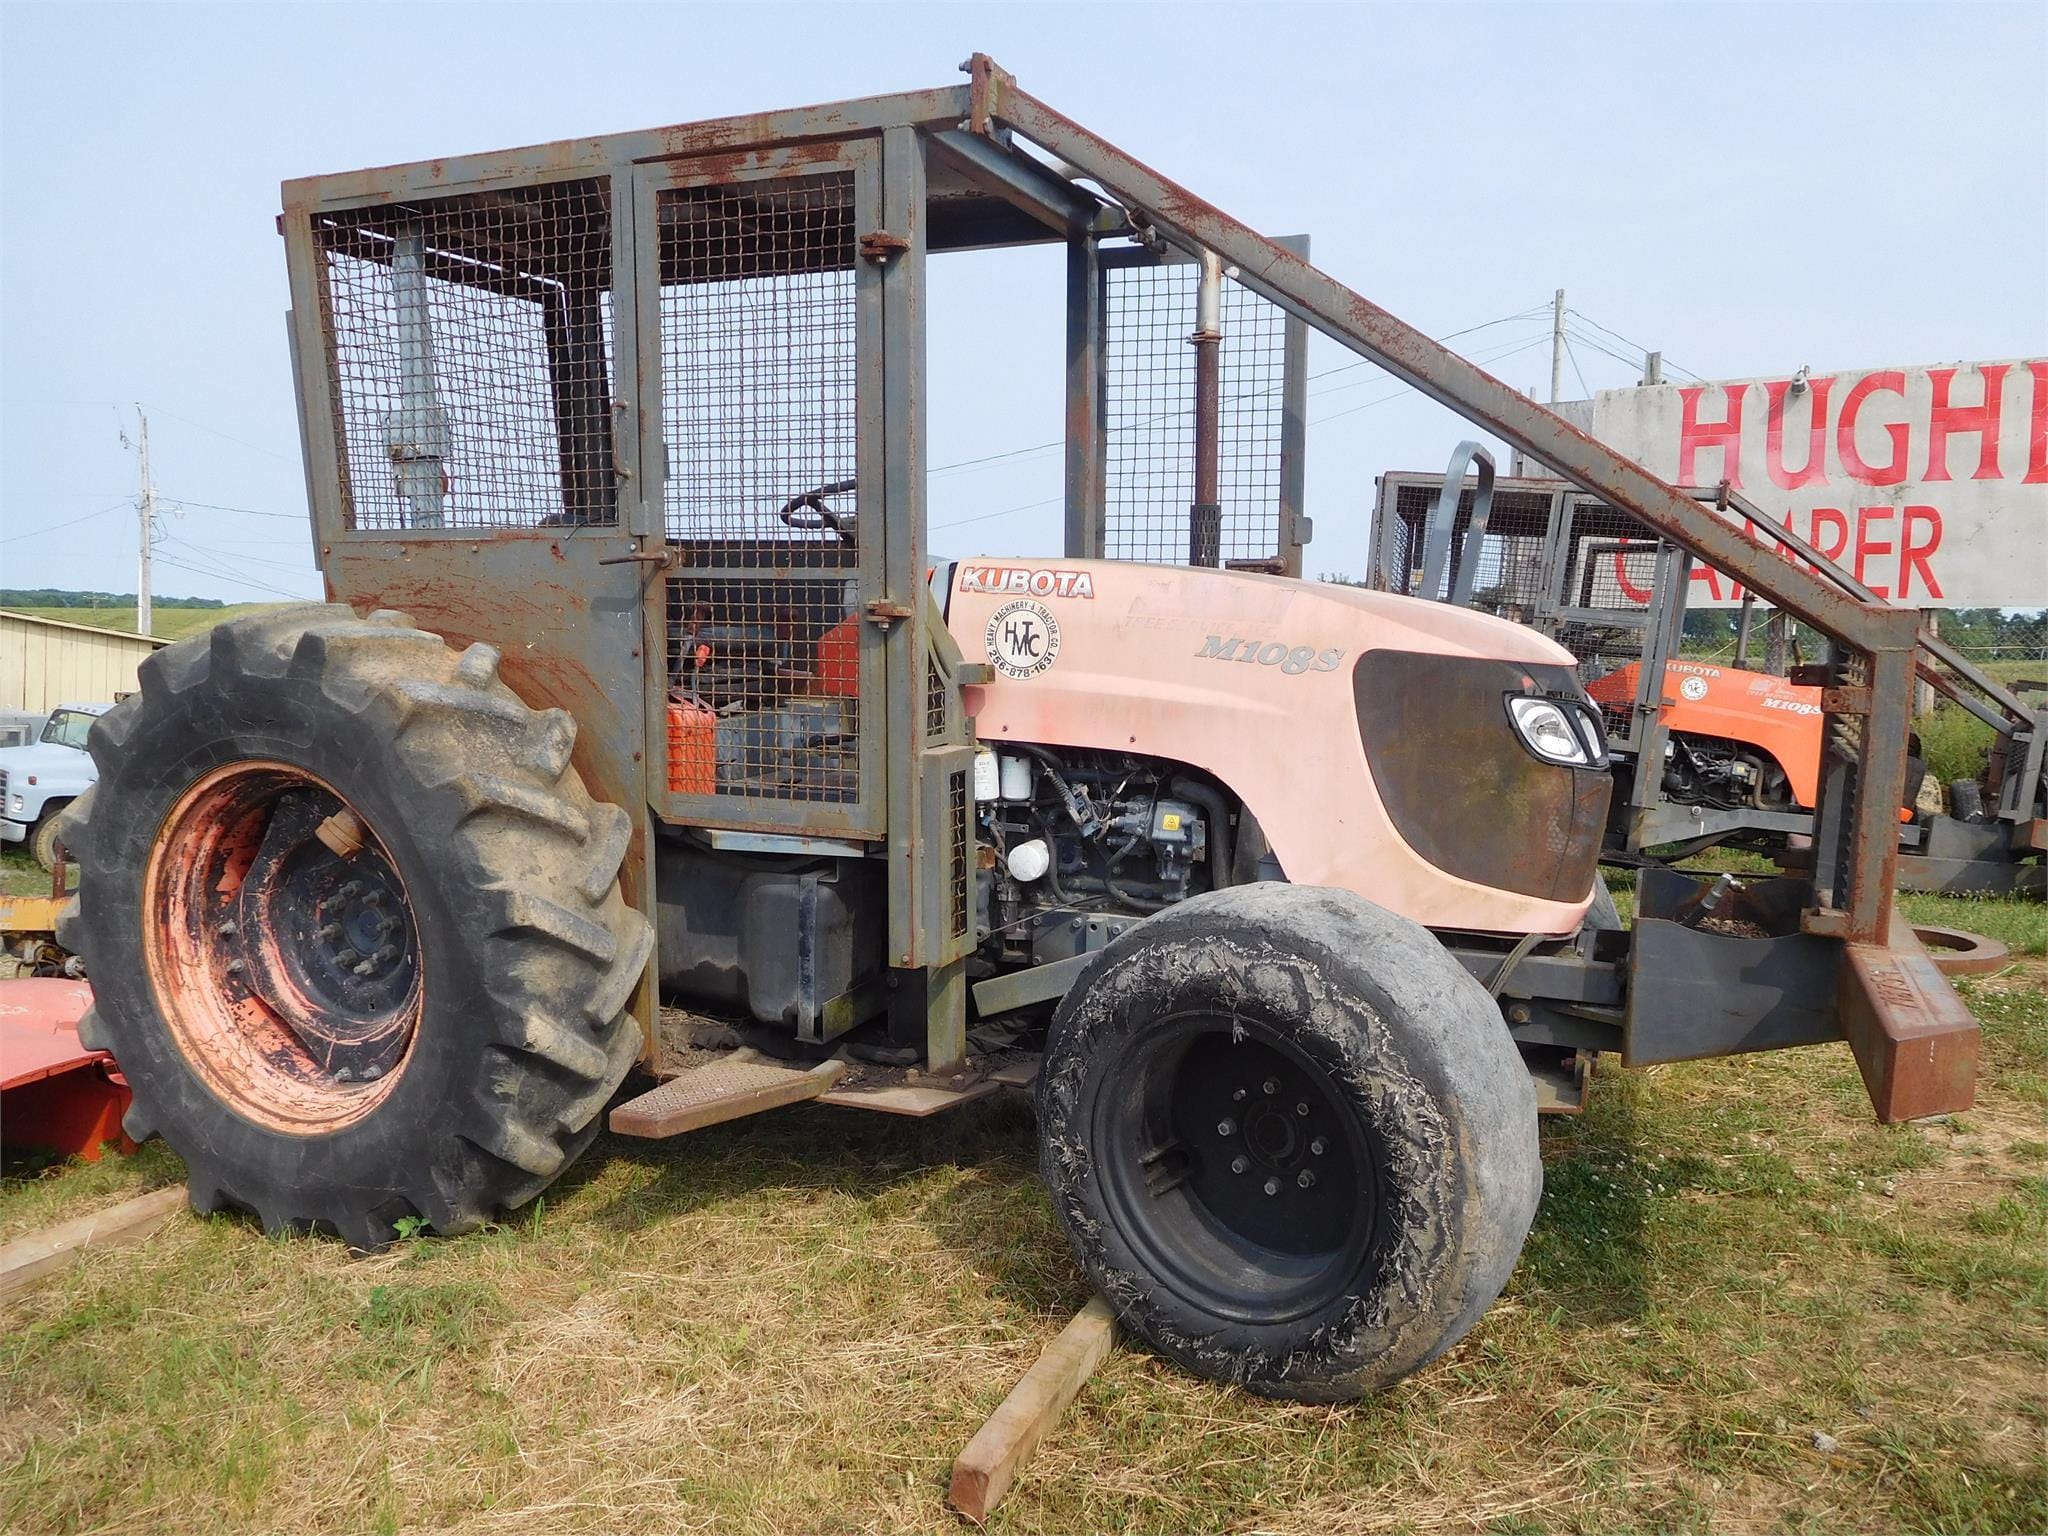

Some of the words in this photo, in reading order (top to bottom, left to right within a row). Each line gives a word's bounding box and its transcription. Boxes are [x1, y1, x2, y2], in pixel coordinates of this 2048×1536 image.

[960, 567, 1094, 599] KUBOTA
[986, 623, 996, 647] HEAVY
[993, 601, 1029, 623] MACHINERY
[1037, 606, 1059, 635] TRACTOR
[988, 649, 1056, 678] 256-878-1631
[1194, 635, 1346, 675] M108S
[1666, 662, 1721, 679] KUBOTA
[1760, 698, 1822, 715] M108S
